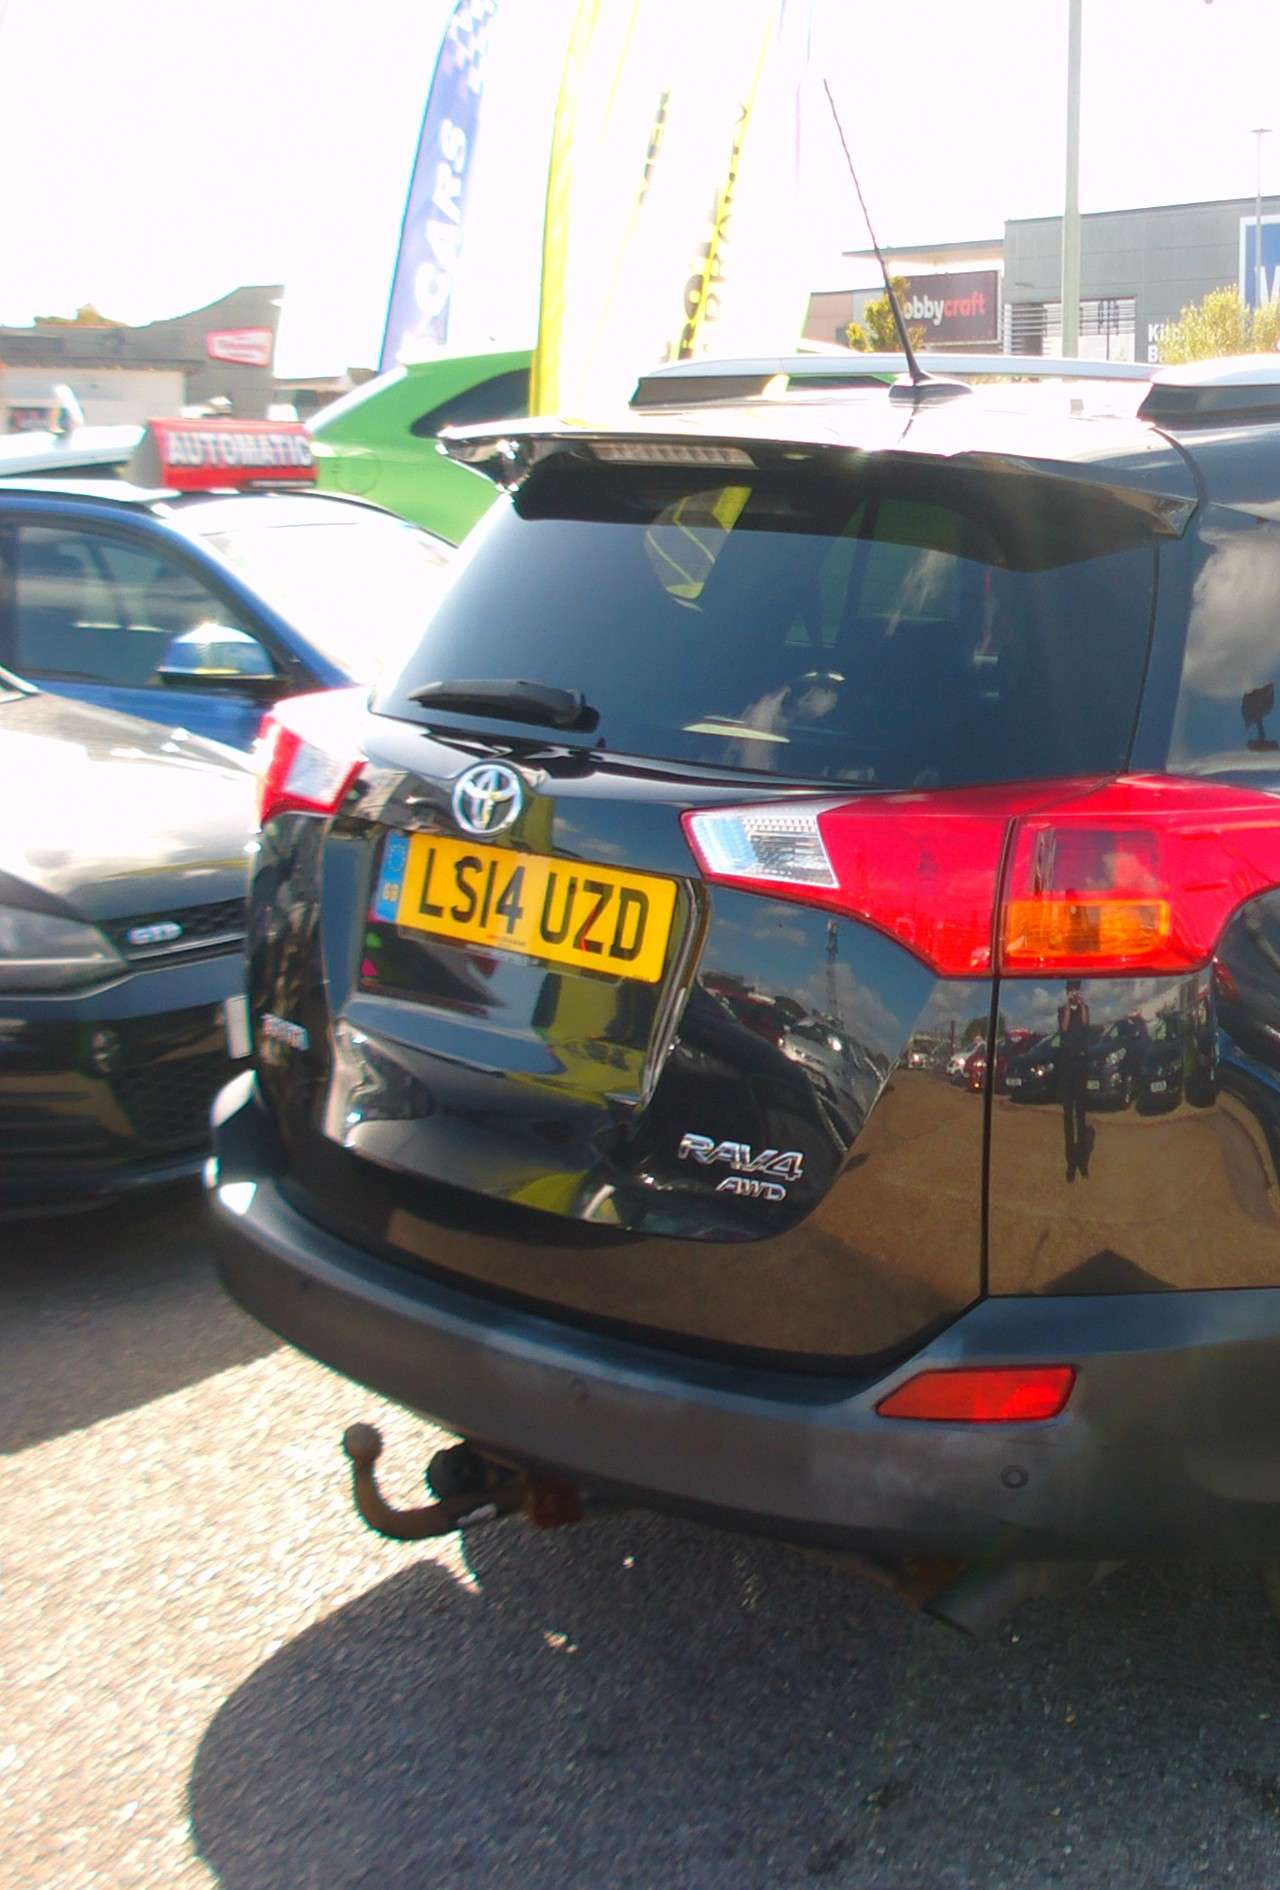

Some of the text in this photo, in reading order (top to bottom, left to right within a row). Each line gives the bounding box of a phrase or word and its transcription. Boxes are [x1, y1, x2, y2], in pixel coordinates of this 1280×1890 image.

[413, 117, 467, 318] CARS
[902, 291, 986, 326] obbycraft
[167, 431, 314, 466] AUTOMATIC
[418, 848, 650, 962] LS14 UZD
[677, 1132, 804, 1182] RAV4
[715, 1176, 787, 1201] AWD
